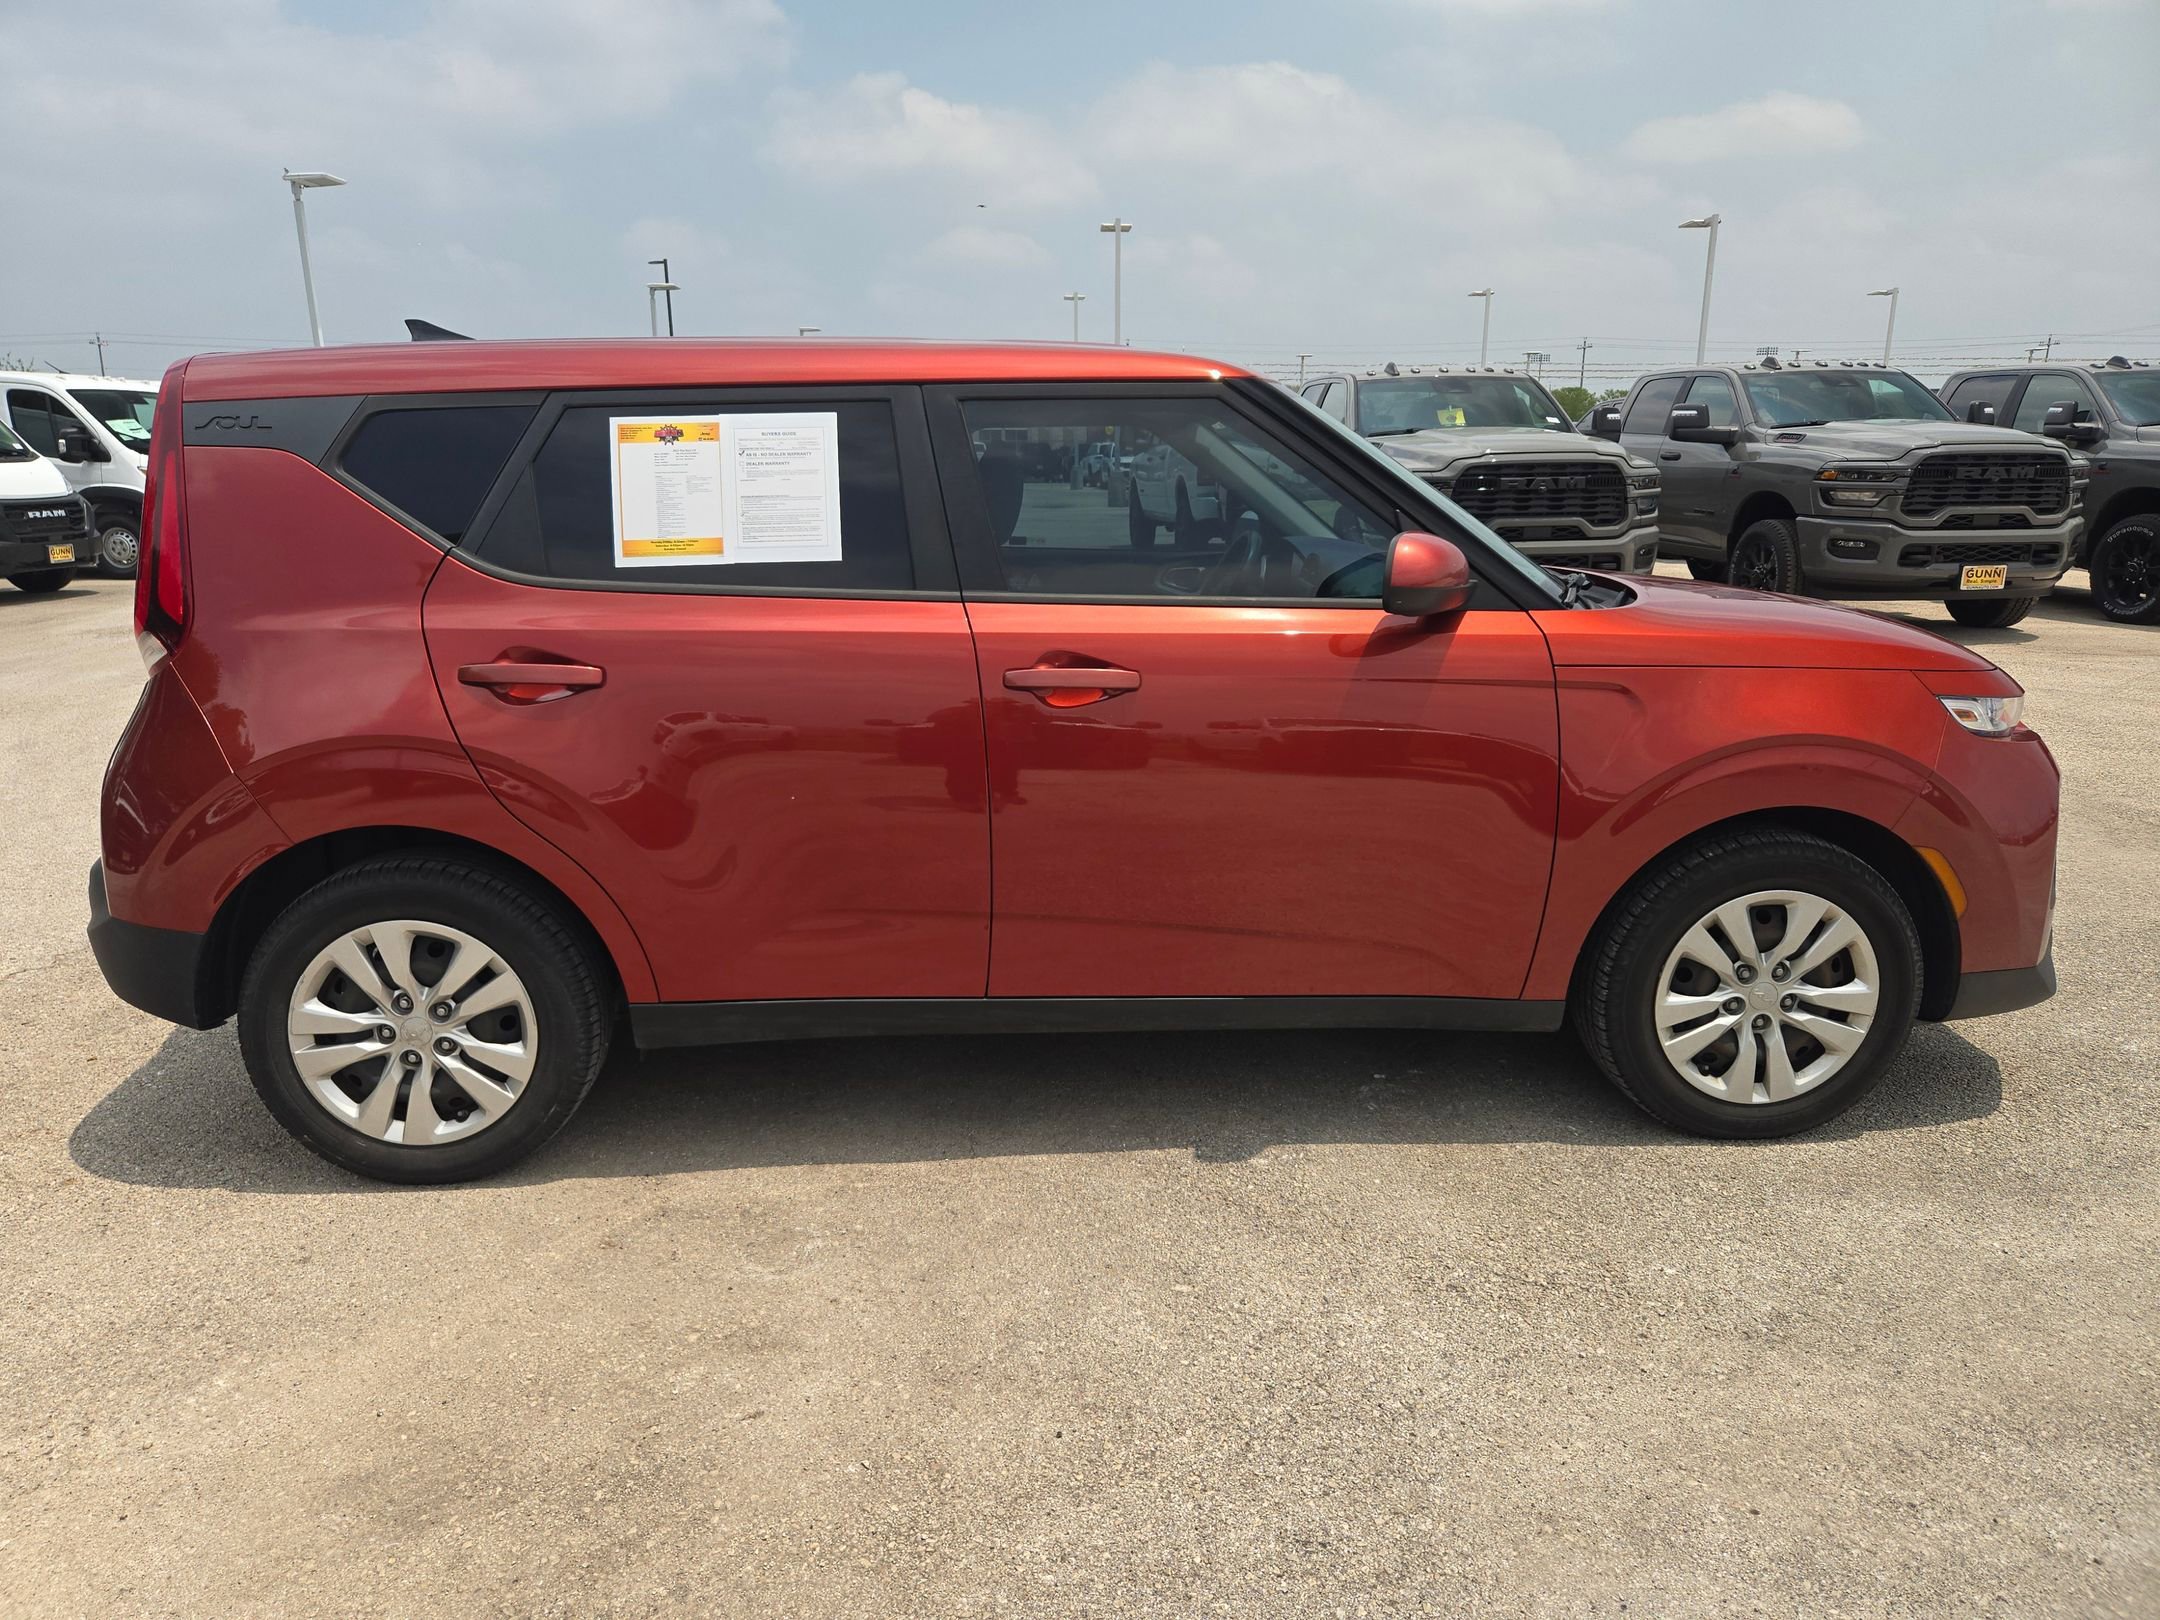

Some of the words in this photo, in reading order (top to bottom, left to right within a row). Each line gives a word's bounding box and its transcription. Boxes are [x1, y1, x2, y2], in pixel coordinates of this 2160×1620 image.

[195, 415, 273, 431] SOUL
[1956, 466, 2036, 480] RAM
[1499, 476, 1586, 490] RAM
[27, 509, 67, 519] RAM
[50, 548, 71, 556] GUNN
[1966, 568, 2002, 579] GUNN
